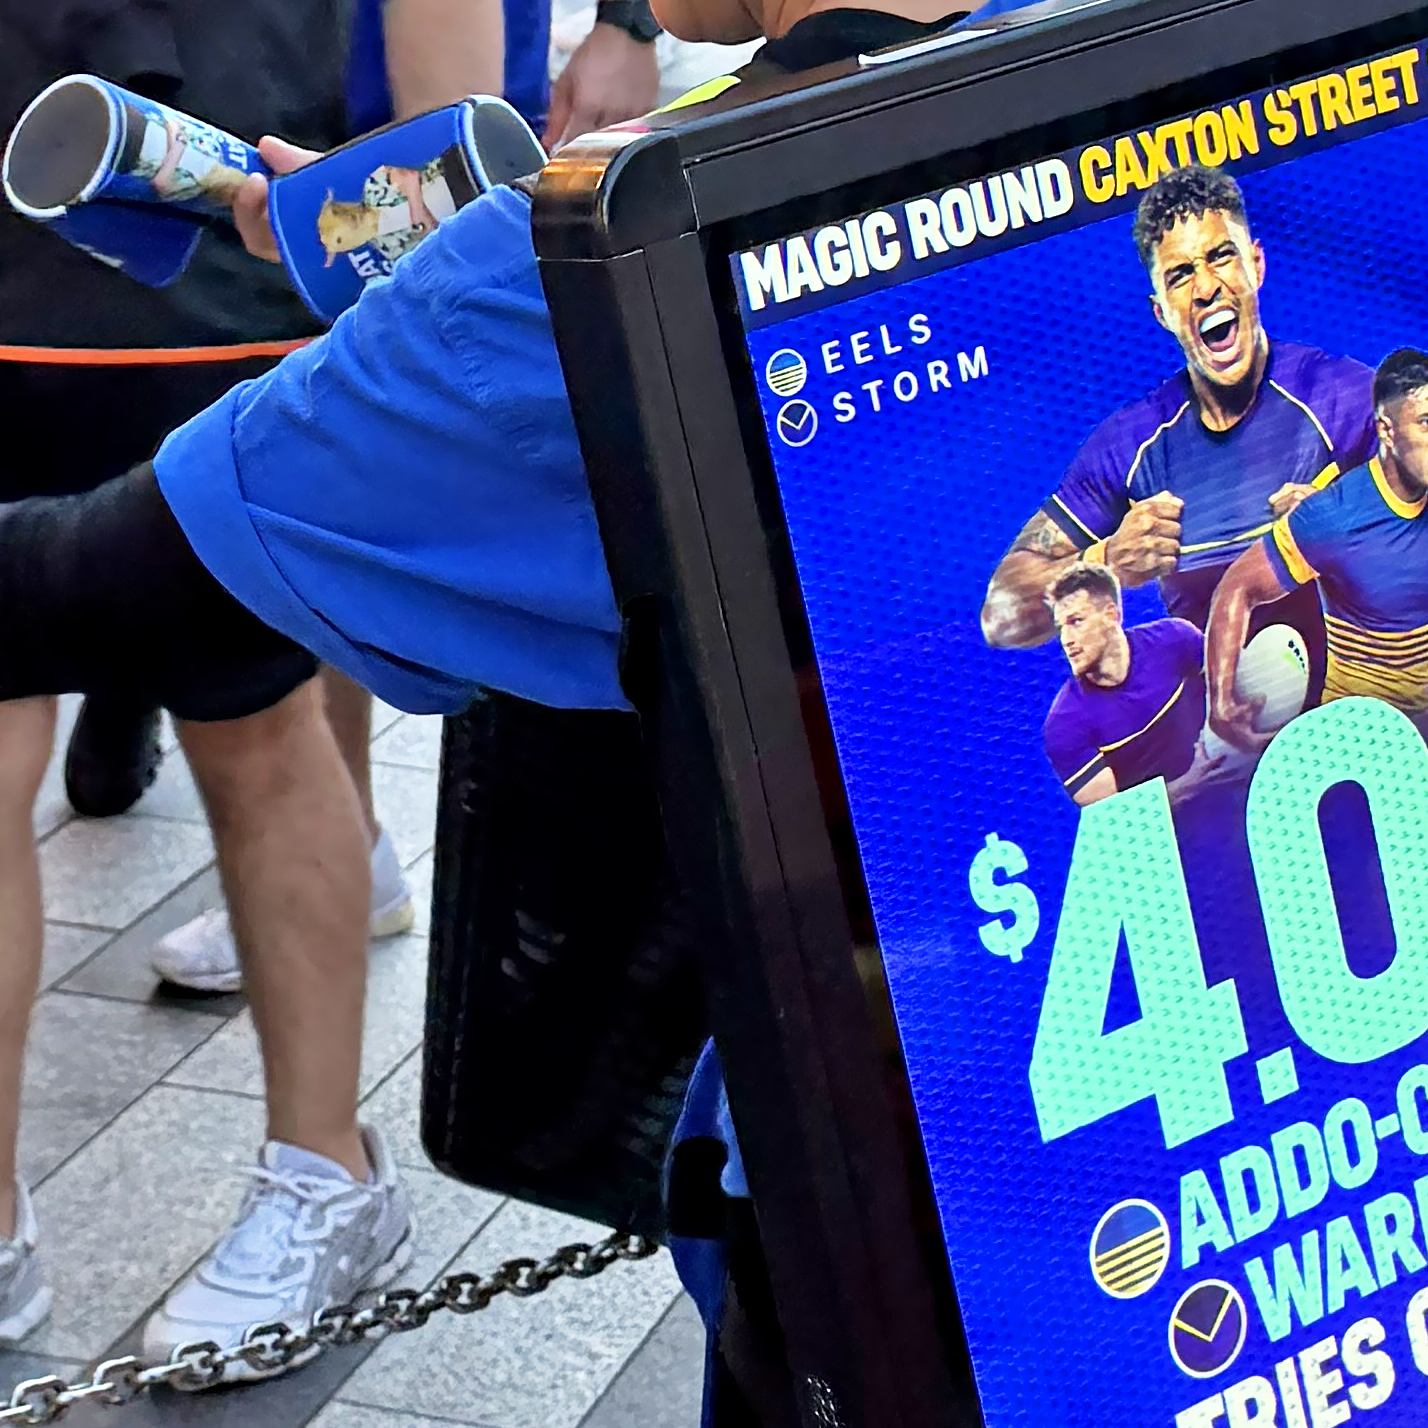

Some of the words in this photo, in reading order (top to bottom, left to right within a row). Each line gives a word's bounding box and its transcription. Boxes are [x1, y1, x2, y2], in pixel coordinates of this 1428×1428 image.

[738, 210, 903, 312] MAGIC
[903, 157, 1075, 261] ROUND
[1078, 98, 1261, 204] CAXTON
[1262, 47, 1420, 147] STREET
[820, 312, 933, 375] EELS
[831, 344, 990, 424] STORM
